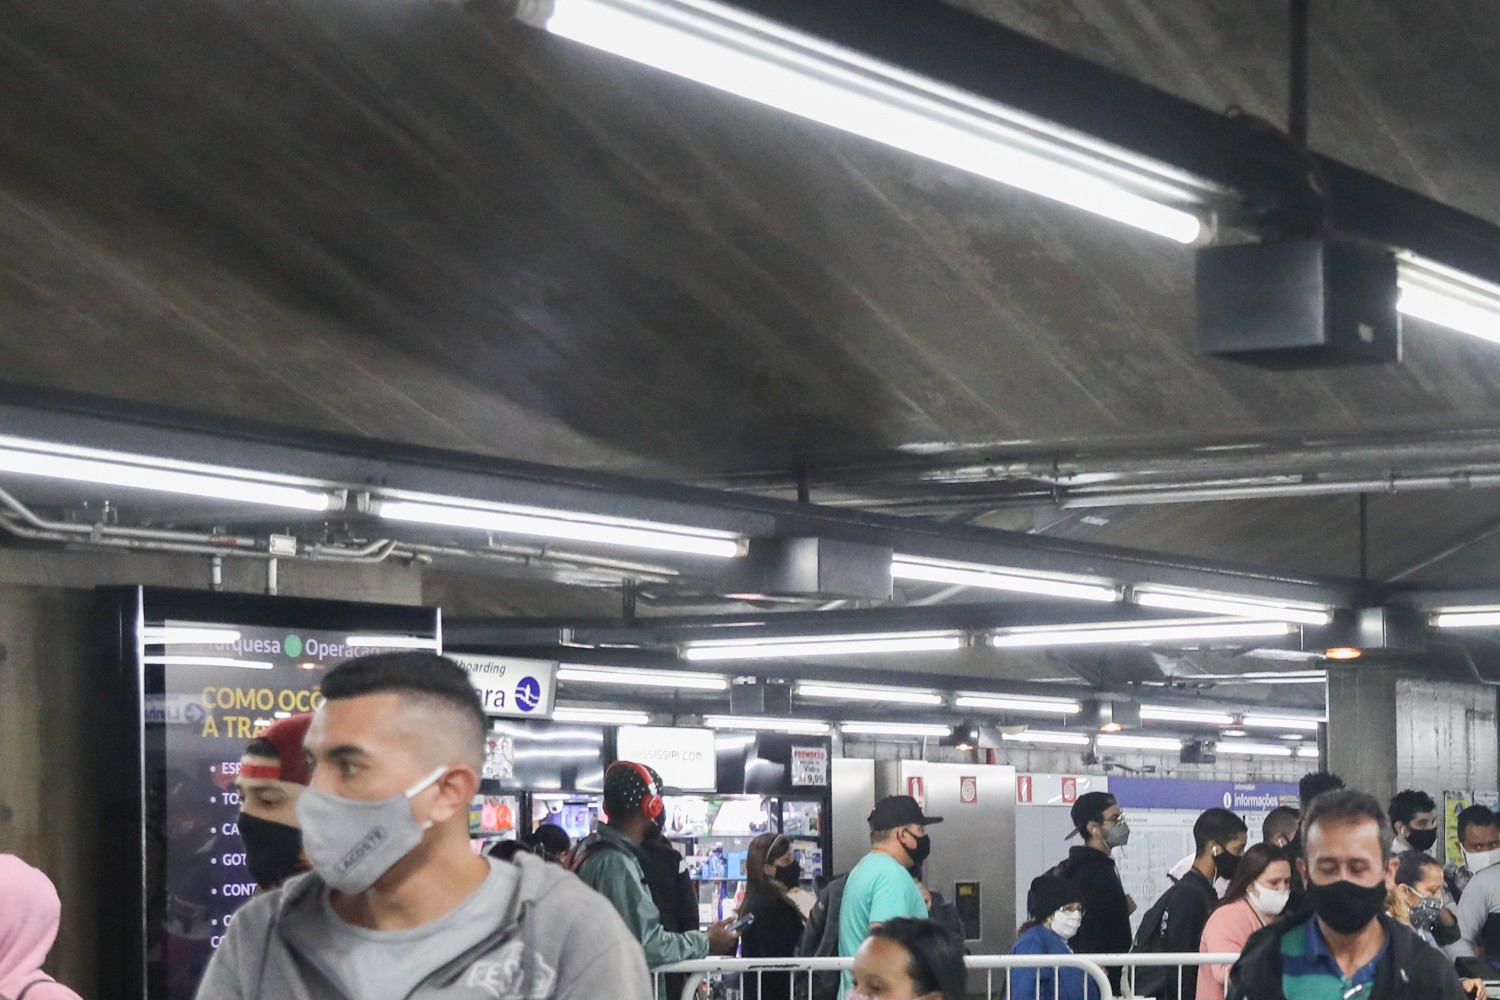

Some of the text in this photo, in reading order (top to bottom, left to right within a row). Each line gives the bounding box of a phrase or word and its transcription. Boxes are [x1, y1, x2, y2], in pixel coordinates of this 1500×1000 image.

[201, 686, 274, 710] COMO
[202, 715, 219, 738] A
[1234, 792, 1279, 811] informações
[222, 883, 257, 896] CONT
